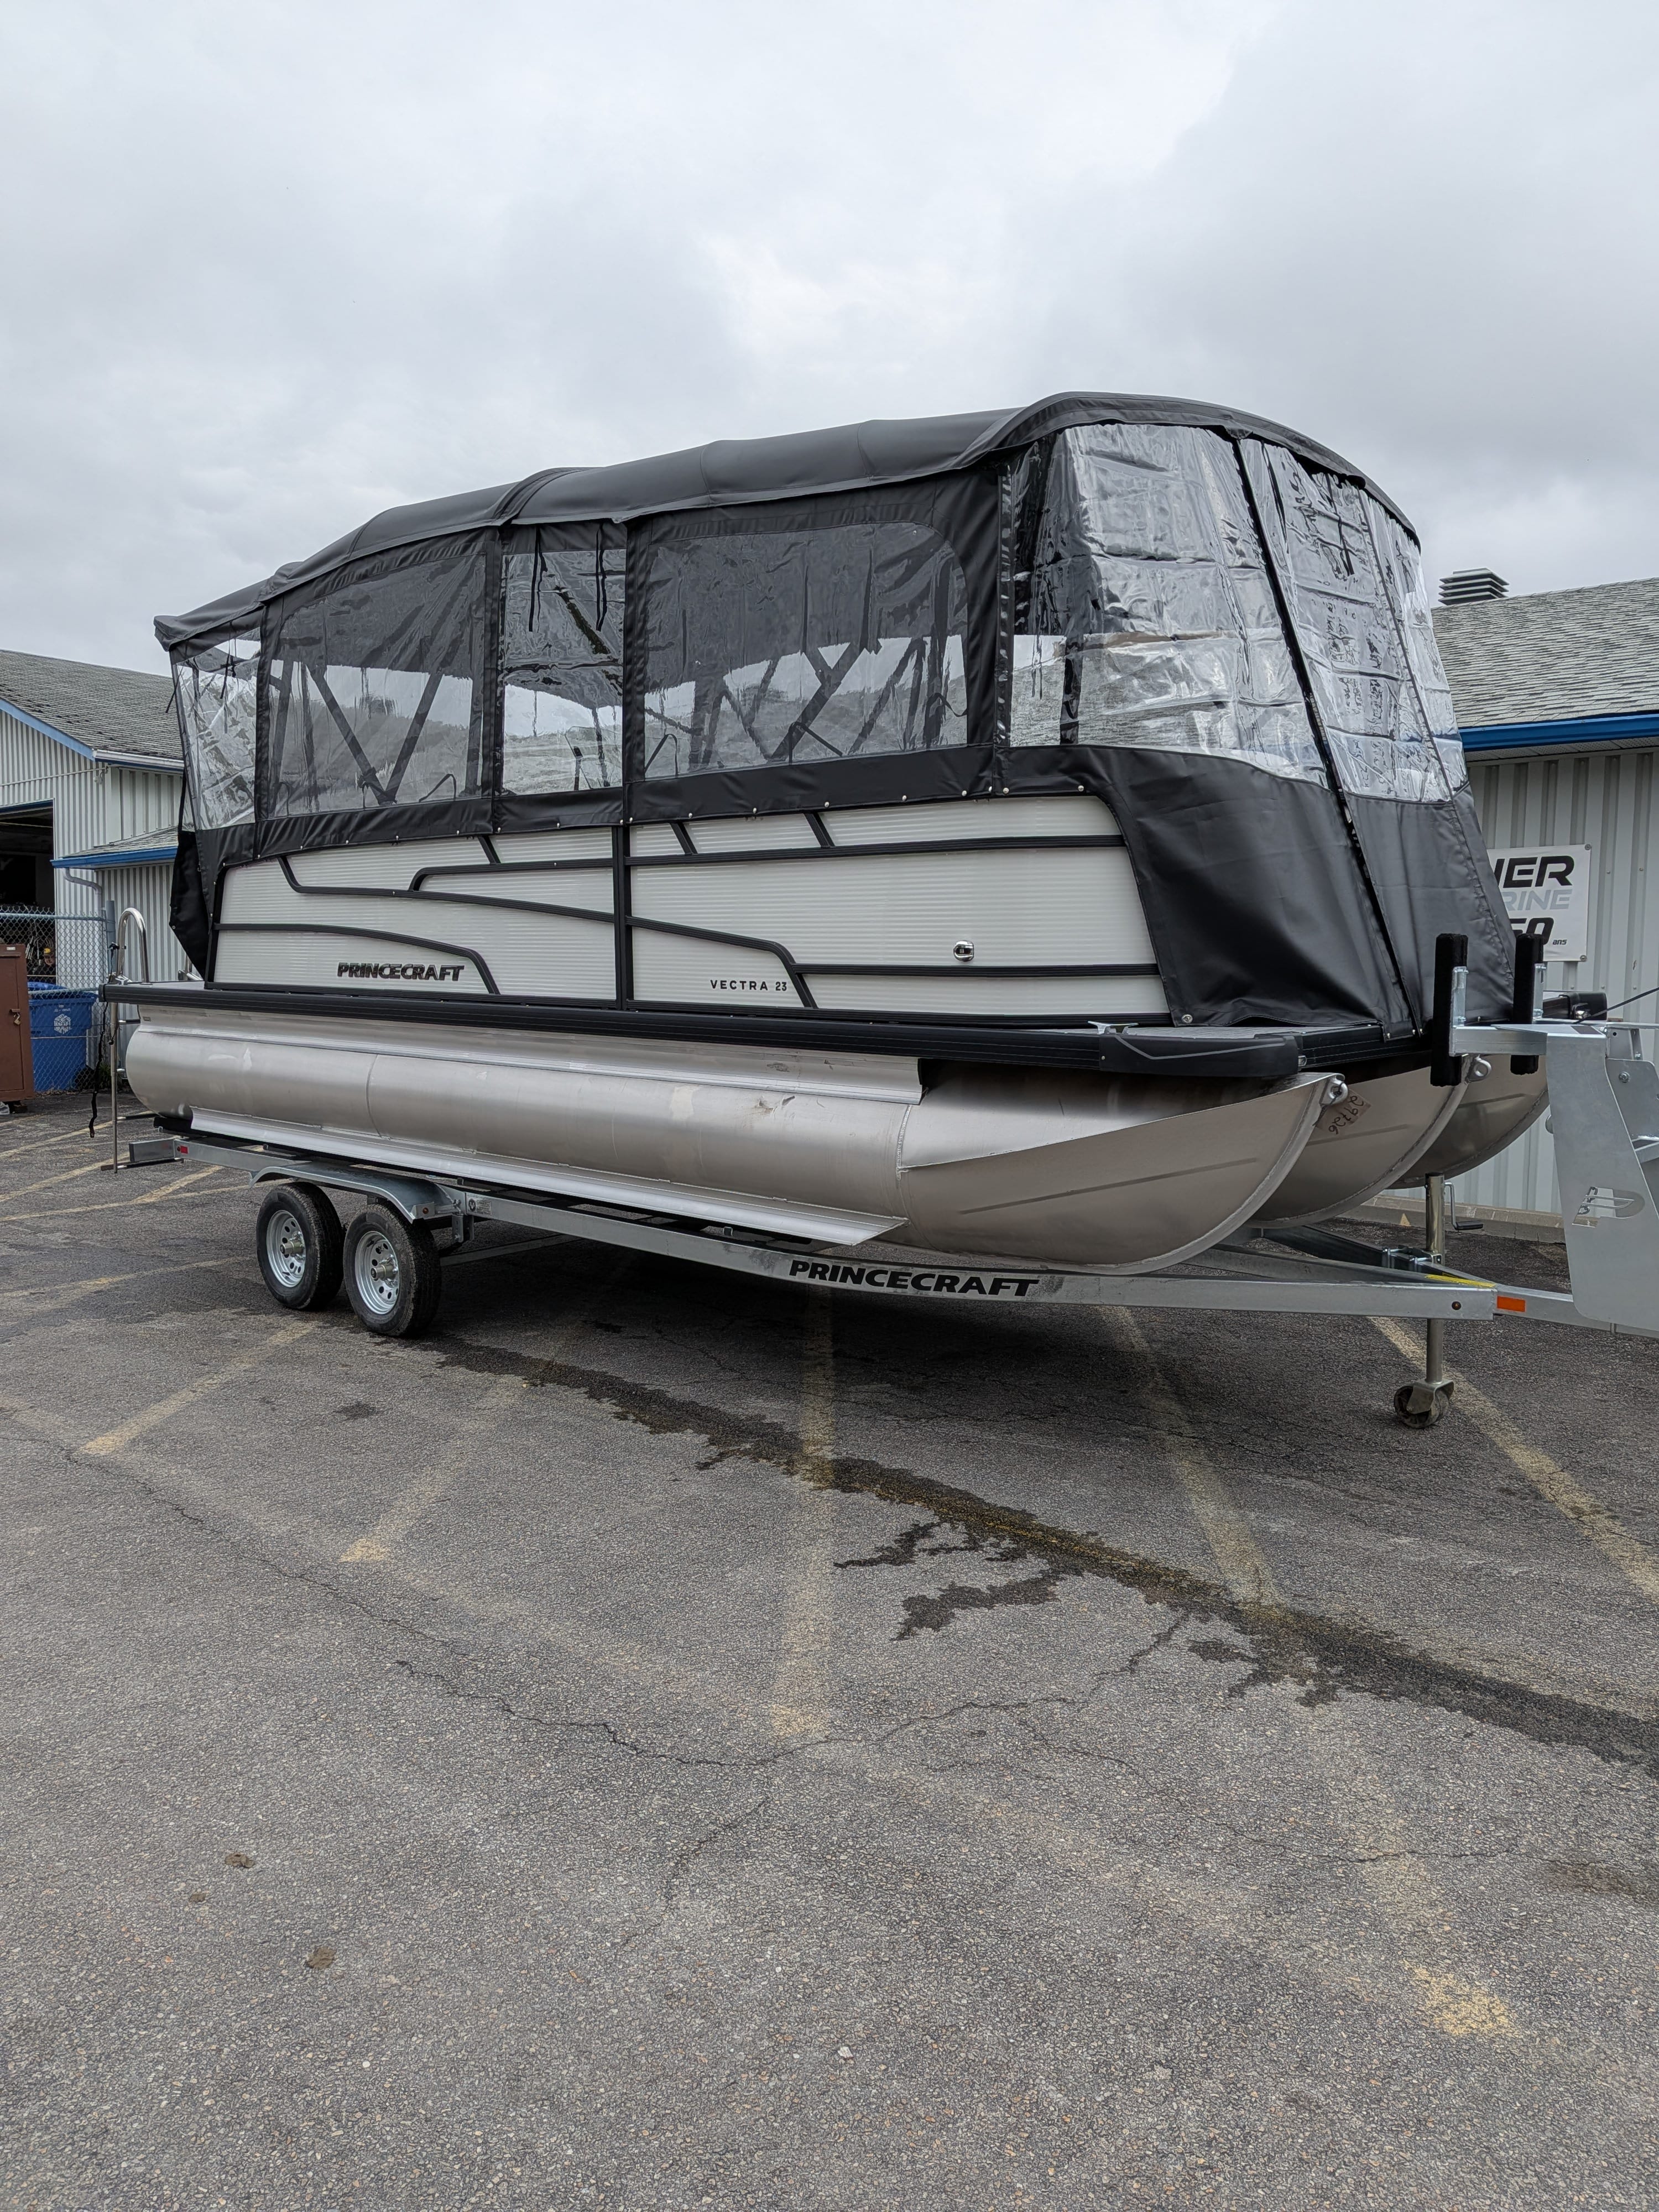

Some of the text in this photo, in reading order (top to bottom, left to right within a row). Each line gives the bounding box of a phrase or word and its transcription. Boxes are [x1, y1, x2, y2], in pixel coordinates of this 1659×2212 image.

[337, 962, 465, 982] PRINCECRAFT
[710, 979, 787, 992] VECTRA 23
[789, 1259, 1040, 1297] PRINCECRAFT
